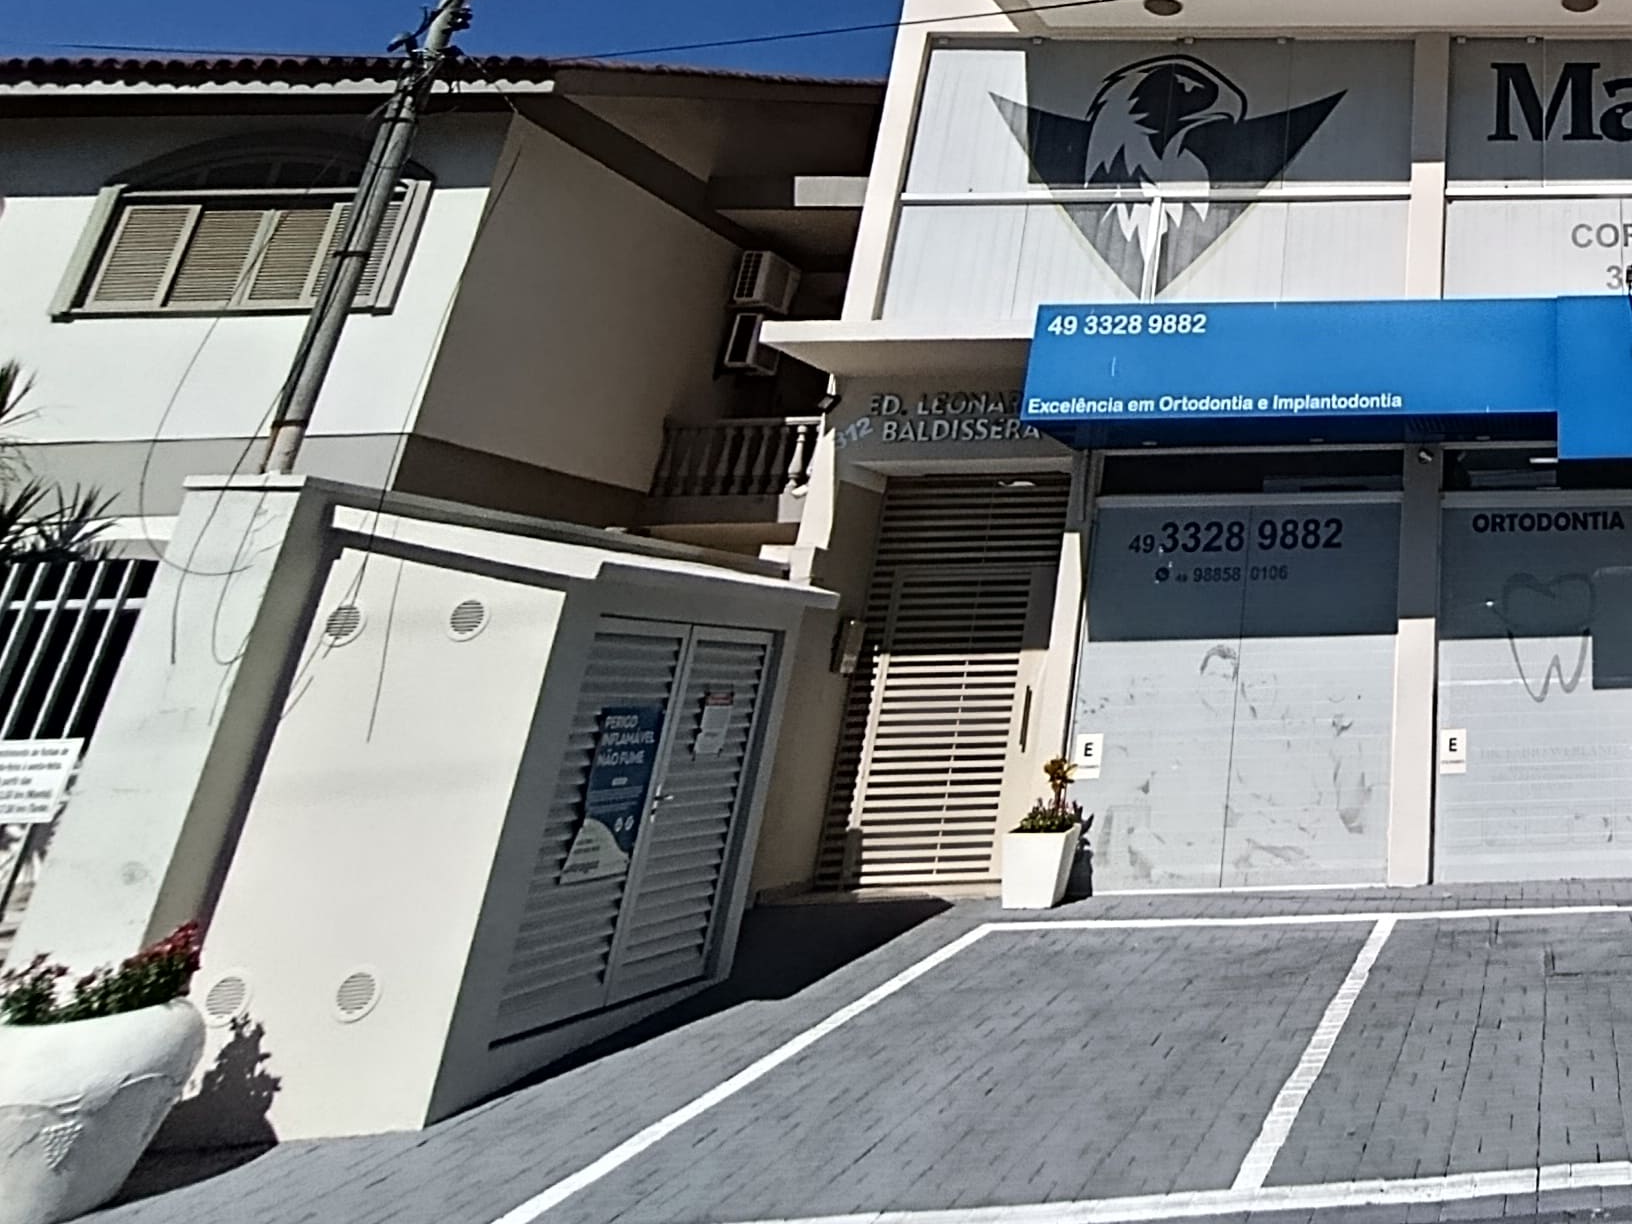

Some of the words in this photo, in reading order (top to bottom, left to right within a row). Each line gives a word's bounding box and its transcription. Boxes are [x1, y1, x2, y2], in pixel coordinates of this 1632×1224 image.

[1047, 315, 1077, 336] 49
[1084, 314, 1143, 336] 3328
[1148, 313, 1207, 335] 9882
[870, 393, 908, 416] ED.
[1027, 397, 1124, 416] Excelência
[1127, 399, 1154, 413] em
[1159, 395, 1254, 413] Ortodontia
[1257, 398, 1268, 411] e
[1273, 392, 1403, 413] Implantodontia
[881, 418, 1040, 442] BALDISSERA
[1472, 510, 1625, 533] ORTODONTIA
[1128, 534, 1155, 554] 49
[1161, 521, 1246, 553] 3328
[1257, 518, 1344, 551] 9882
[604, 714, 639, 729] PERIGO
[601, 727, 655, 747] INFLAMÁVEL
[1449, 737, 1458, 752] E
[597, 748, 618, 767] NÃO
[1084, 742, 1094, 757] E
